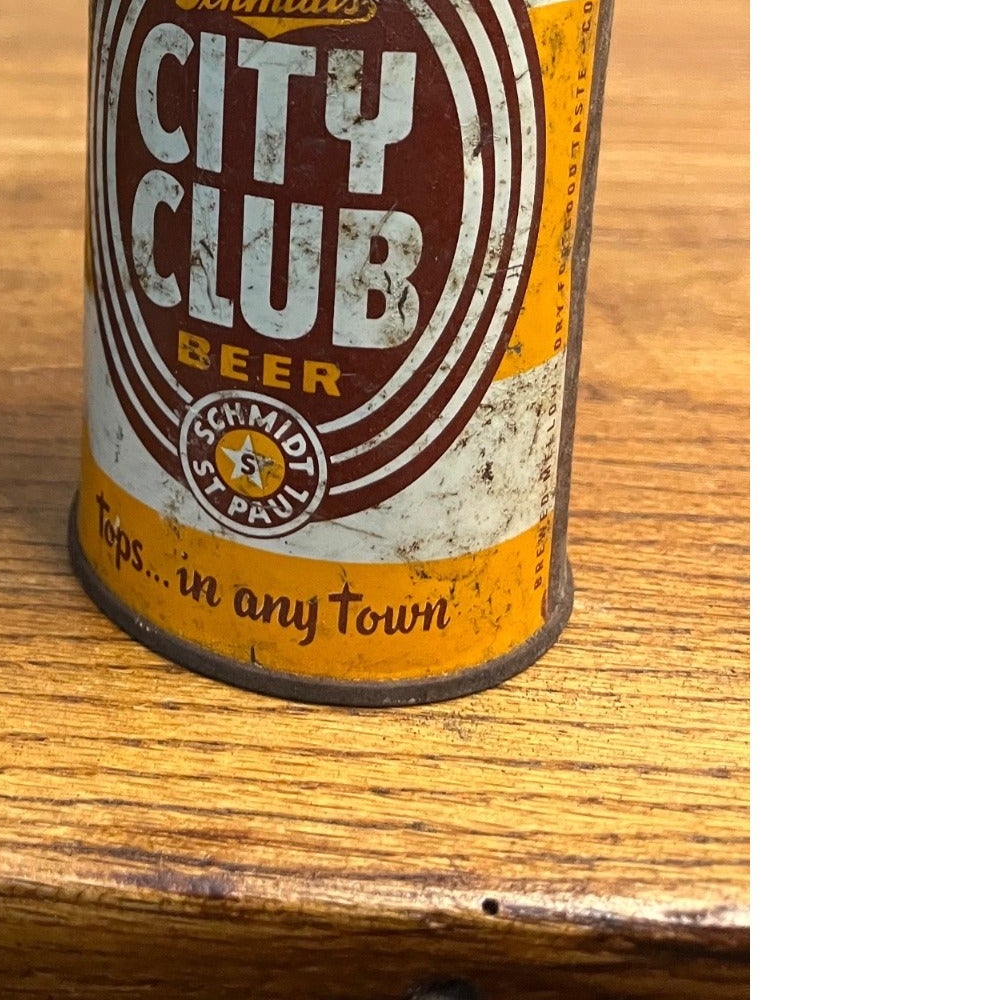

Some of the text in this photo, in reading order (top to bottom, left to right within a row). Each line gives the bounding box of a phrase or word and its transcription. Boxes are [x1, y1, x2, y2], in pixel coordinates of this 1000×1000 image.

[136, 22, 417, 194] CITY
[131, 169, 423, 349] CLUB
[177, 330, 341, 397] BEER
[533, 493, 550, 591] BREWED
[553, 304, 564, 351] DRY
[564, 163, 578, 231] GOOD
[571, 68, 587, 153] TASTE
[194, 402, 315, 476] SCHMIDT
[240, 453, 256, 475] S
[227, 485, 310, 523] PAUL
[176, 551, 221, 607] in
[233, 586, 319, 646] any
[328, 580, 451, 635] town
